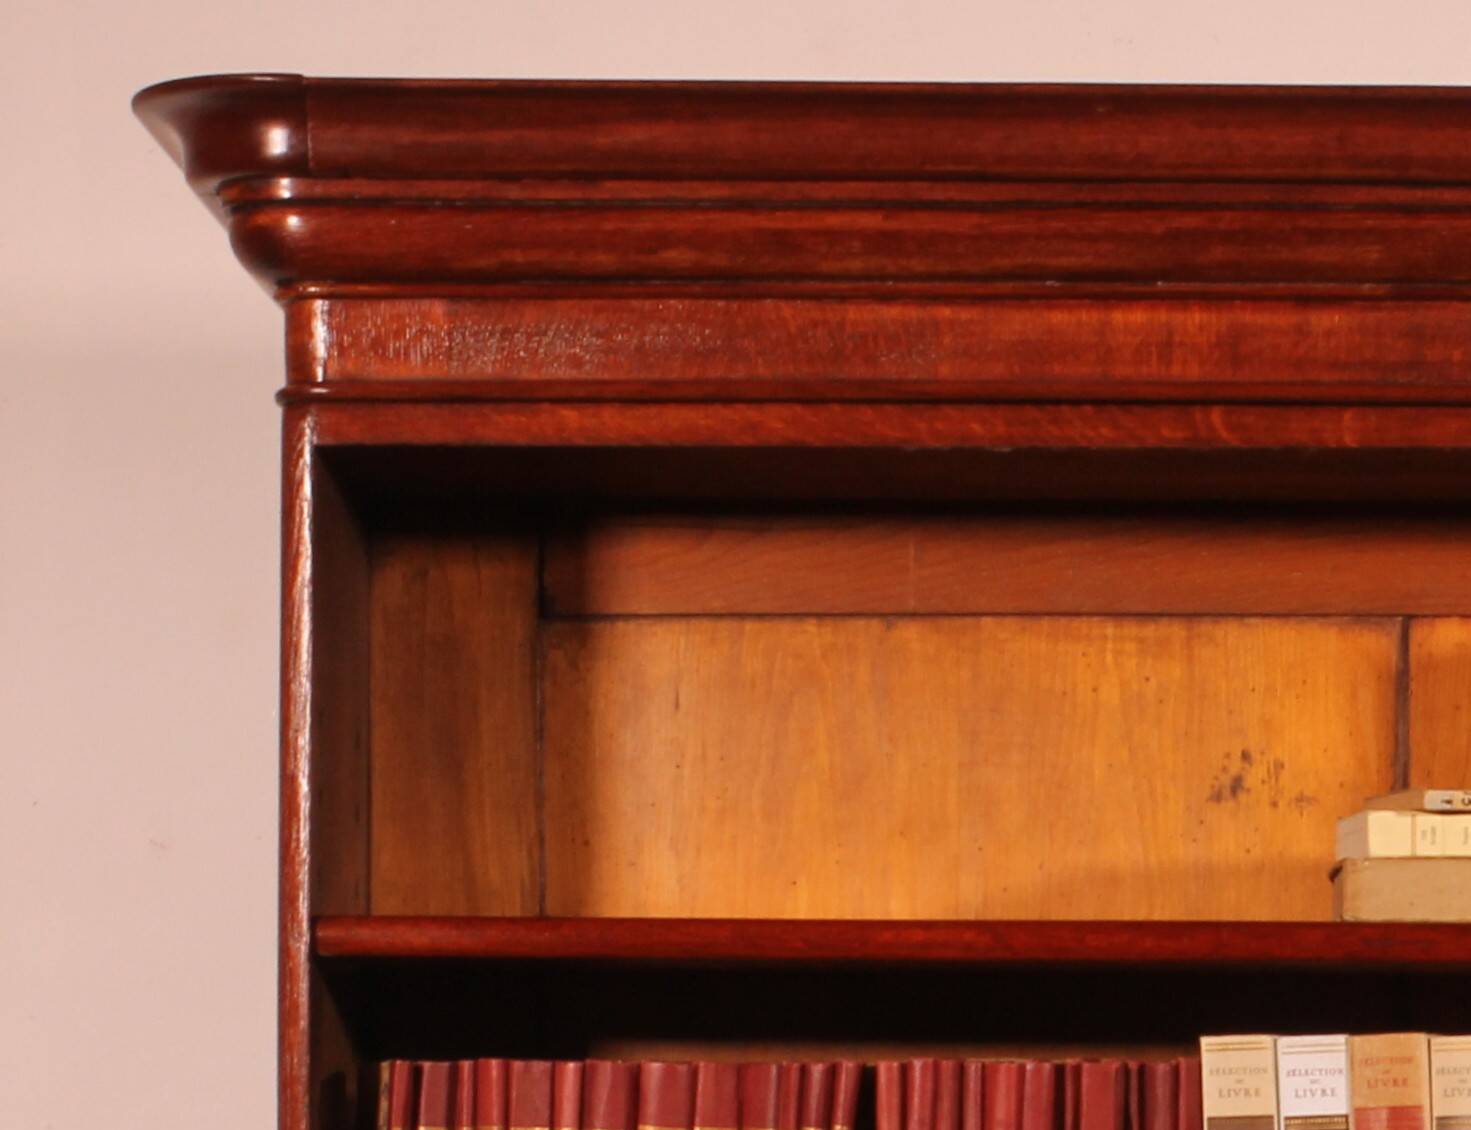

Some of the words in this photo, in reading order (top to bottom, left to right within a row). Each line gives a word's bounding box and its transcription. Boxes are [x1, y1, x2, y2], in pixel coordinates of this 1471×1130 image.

[1367, 1078, 1408, 1088] LIVRE
[1218, 1088, 1260, 1098] LIVRE
[1295, 1088, 1337, 1098] LIVRE
